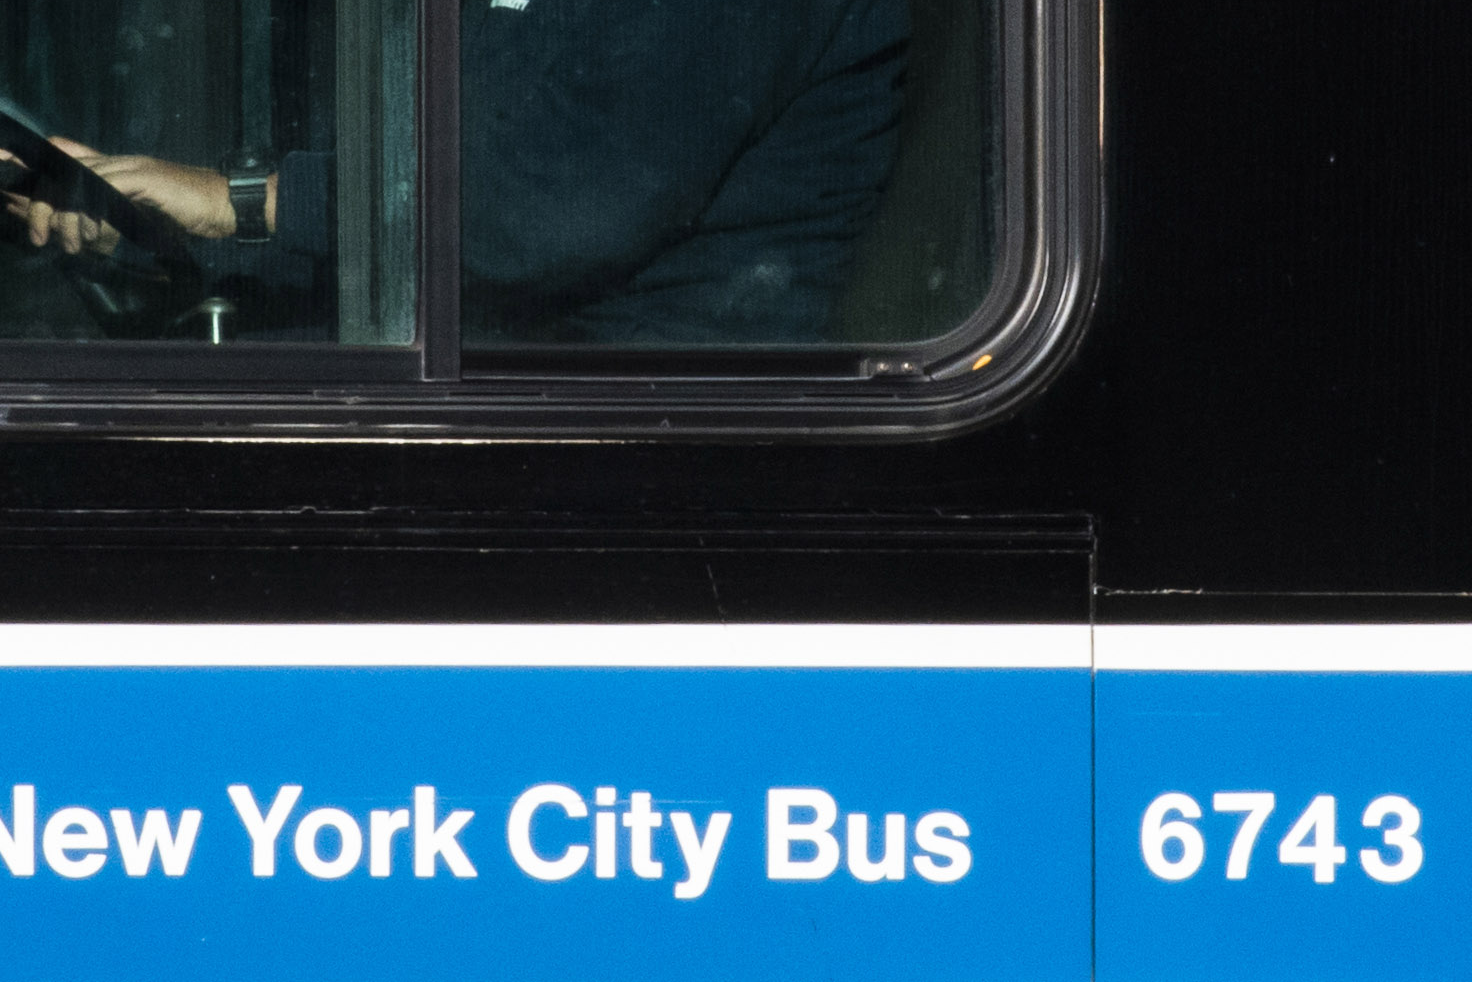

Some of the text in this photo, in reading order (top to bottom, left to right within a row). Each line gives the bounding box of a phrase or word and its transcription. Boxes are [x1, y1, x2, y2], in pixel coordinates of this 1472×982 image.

[227, 784, 478, 879] York
[507, 782, 732, 899] City
[767, 788, 972, 883] Bus
[1140, 791, 1425, 884] 6743
